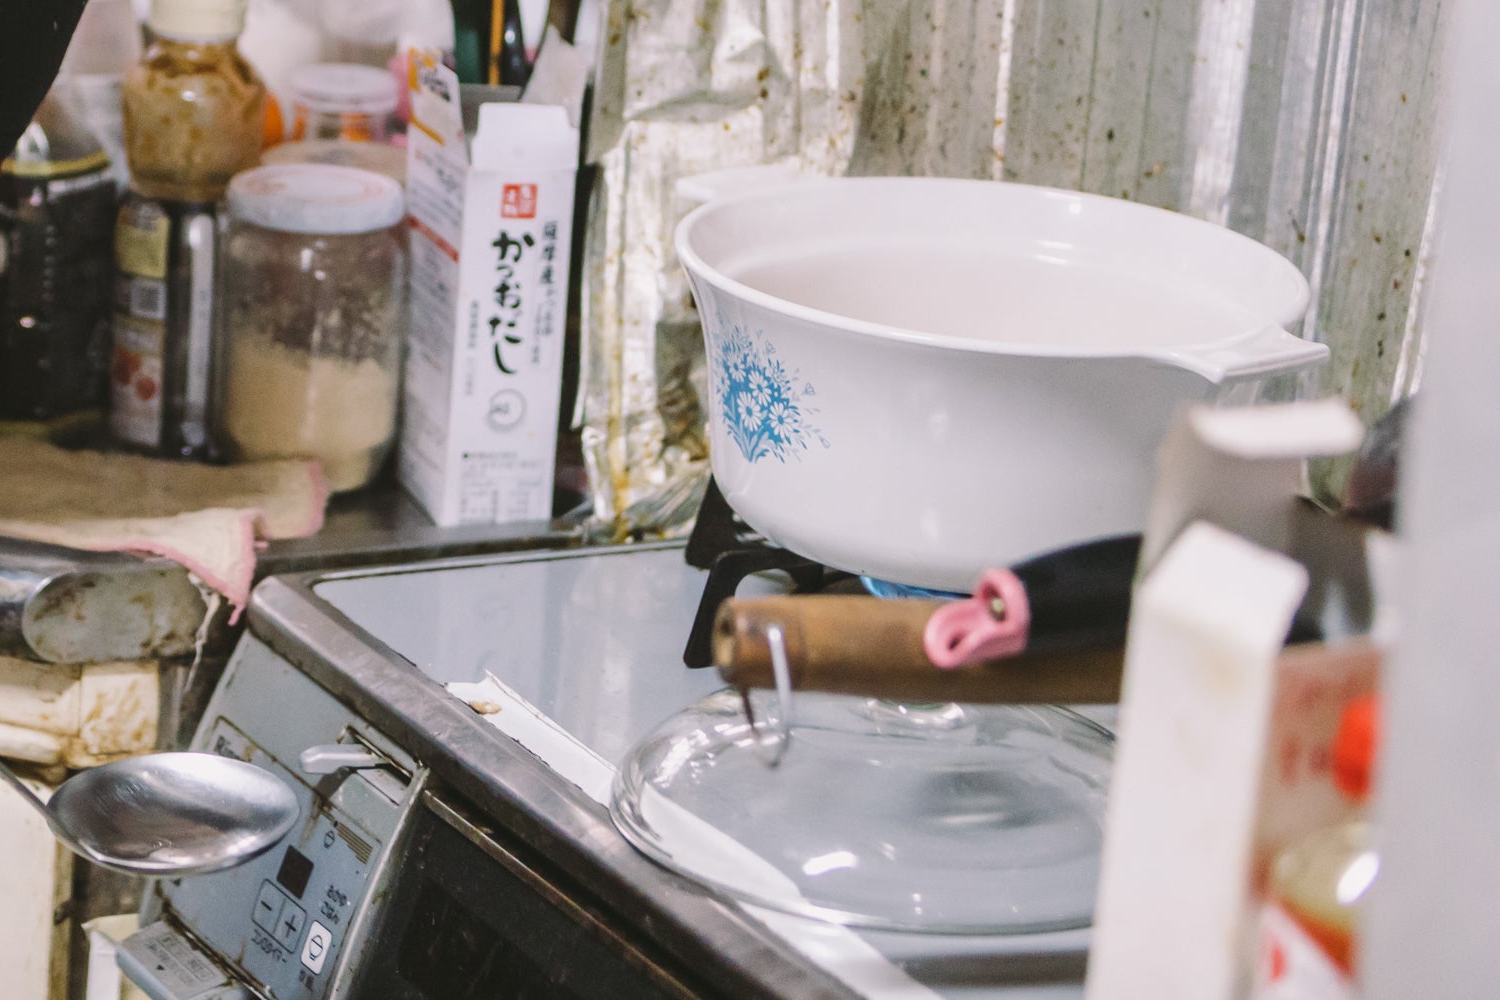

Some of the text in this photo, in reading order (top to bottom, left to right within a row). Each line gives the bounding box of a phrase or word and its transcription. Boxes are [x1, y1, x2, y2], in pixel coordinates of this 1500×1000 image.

[487, 231, 535, 375] かつおだし
